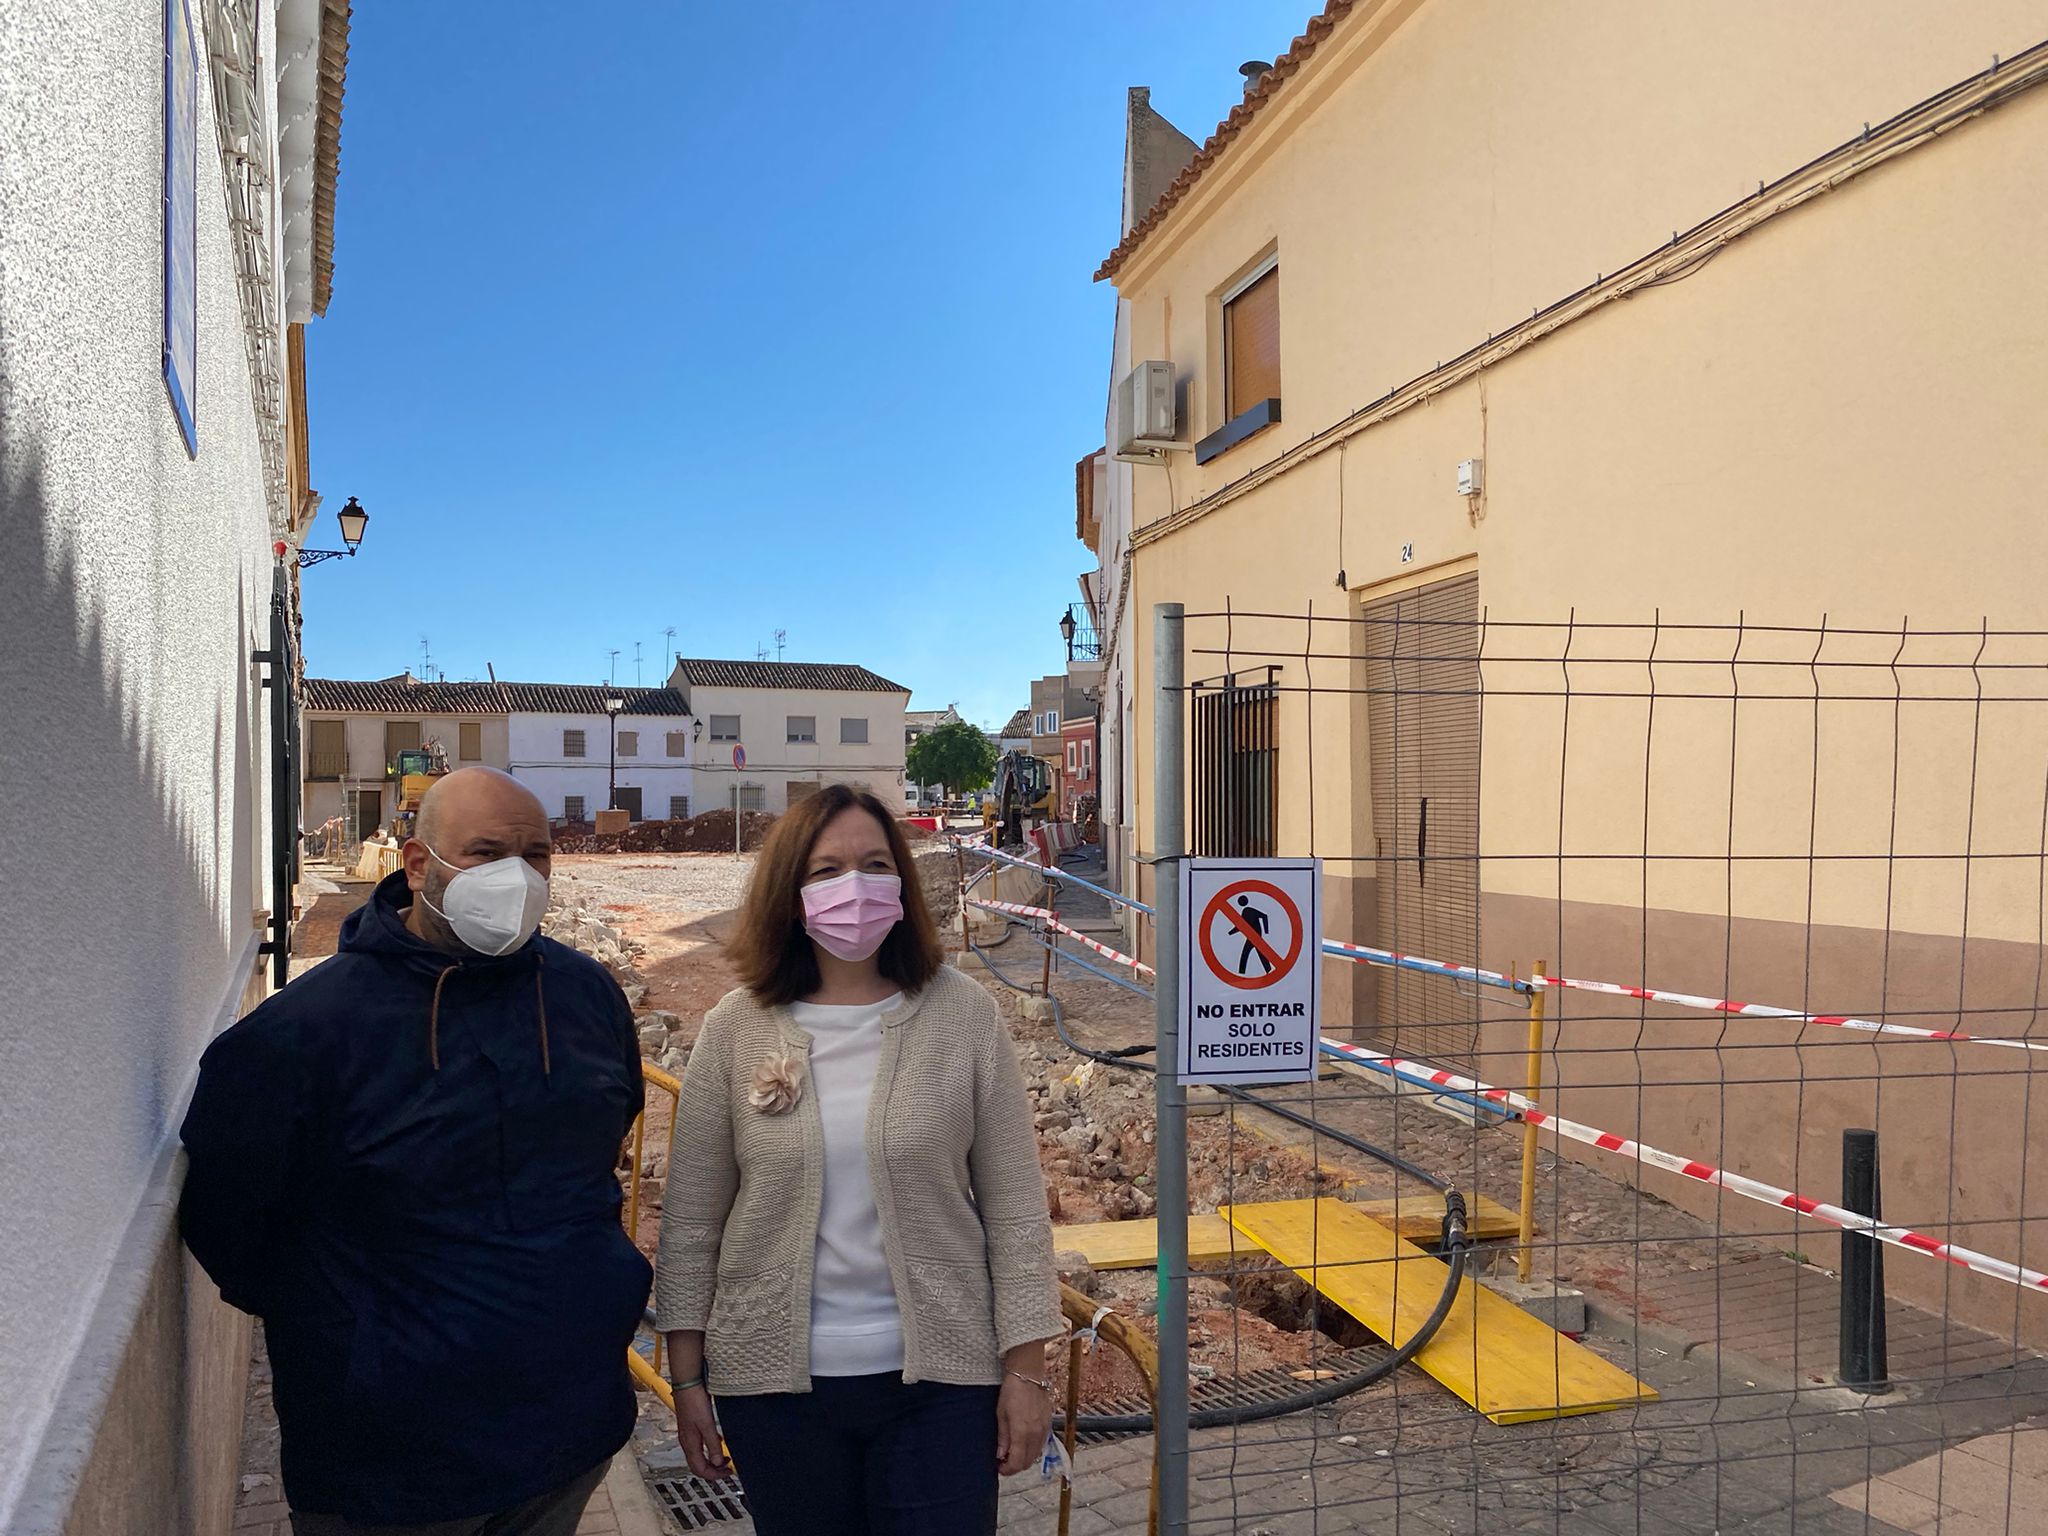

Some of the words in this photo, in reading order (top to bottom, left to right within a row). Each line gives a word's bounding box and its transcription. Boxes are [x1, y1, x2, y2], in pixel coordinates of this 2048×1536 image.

[1402, 543, 1412, 562] 24
[1197, 1004, 1224, 1019] NO
[1230, 1003, 1305, 1018] ENTRAR
[1228, 1023, 1275, 1037] SOLO
[1198, 1041, 1304, 1058] RESIDENTES
